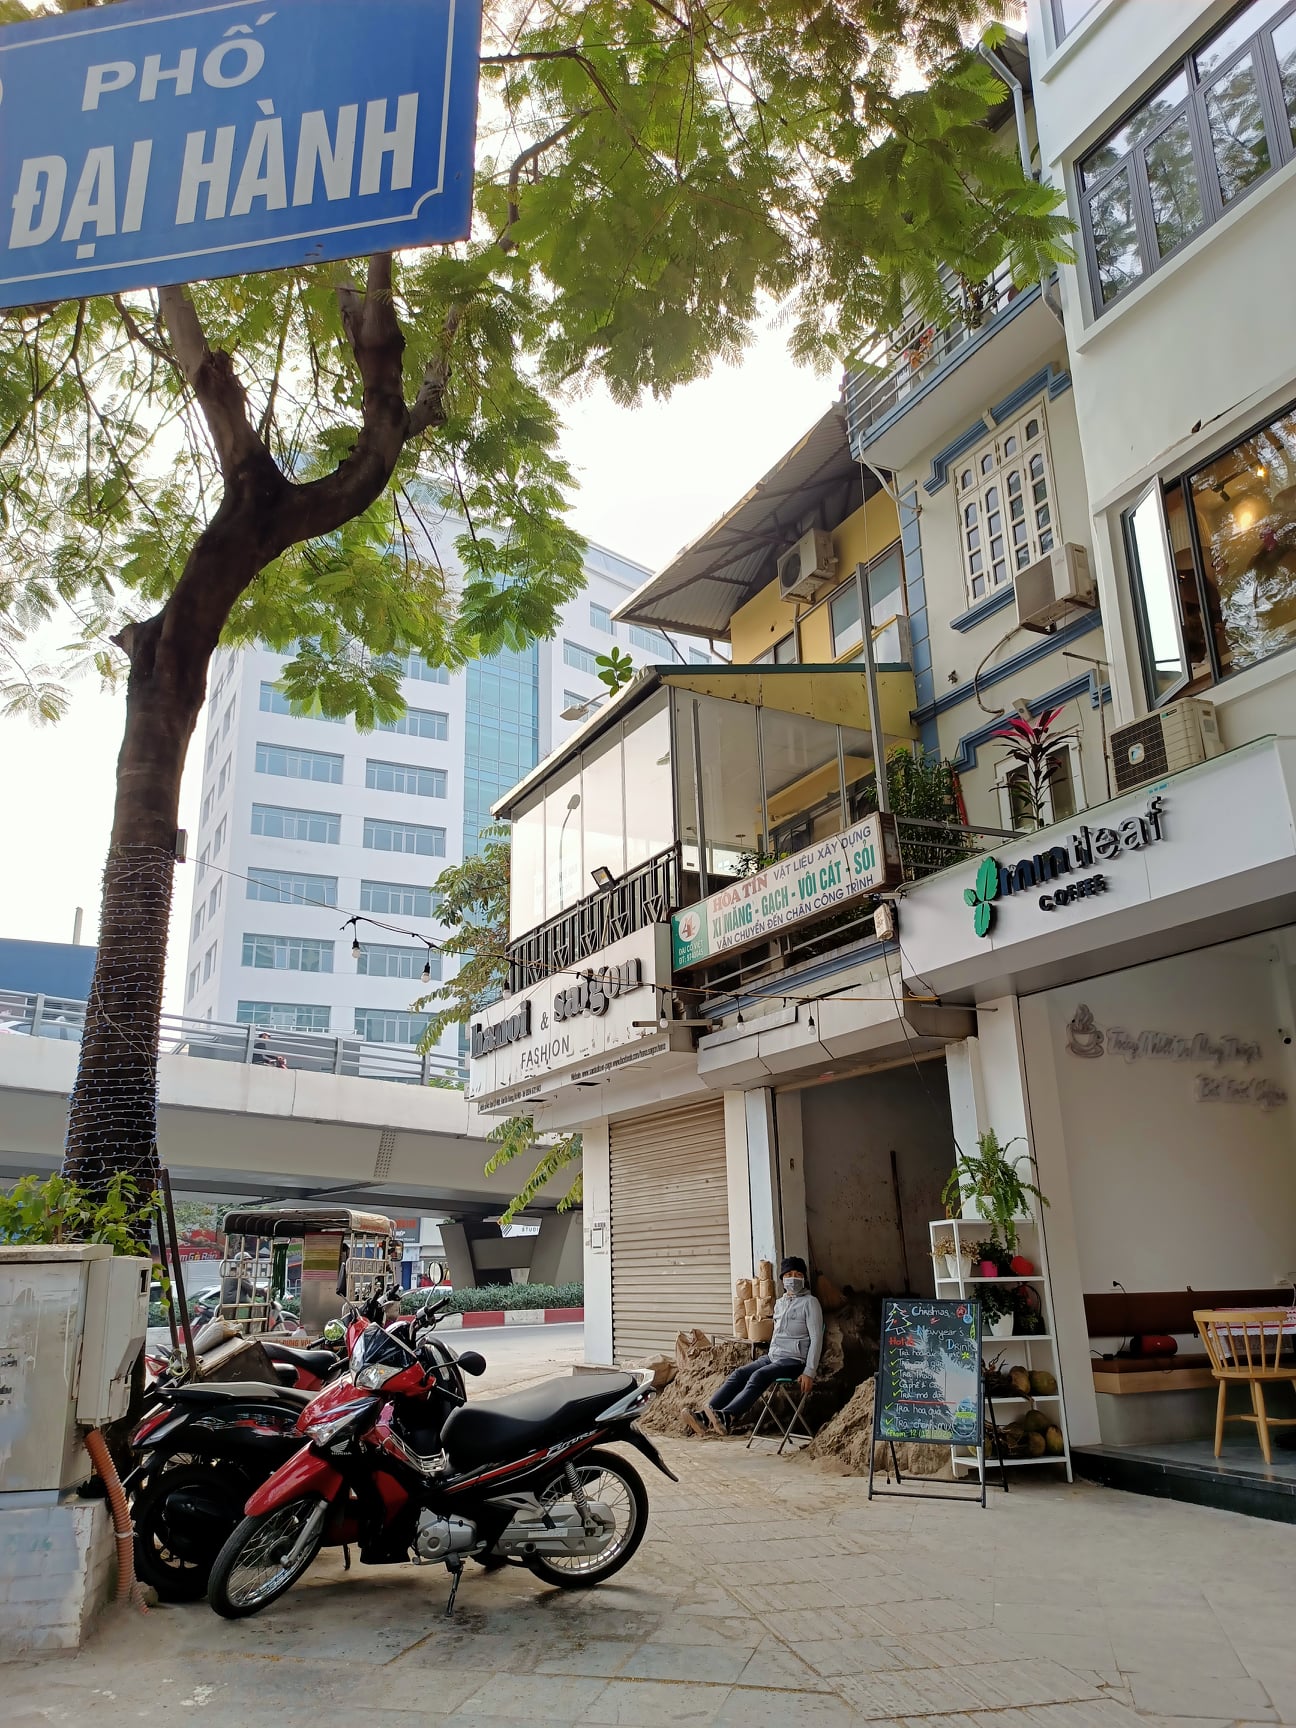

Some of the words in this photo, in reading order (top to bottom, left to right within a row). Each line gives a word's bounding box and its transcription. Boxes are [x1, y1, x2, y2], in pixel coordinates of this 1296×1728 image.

[81, 12, 277, 112] PHỐ
[8, 139, 153, 260] ĐẠI
[175, 92, 419, 226] HÀNH
[712, 917, 722, 939] XI
[724, 902, 753, 934] MĂNG
[761, 886, 789, 917] GẠCH
[798, 870, 817, 900] VÔI
[819, 860, 842, 890] CÁT
[854, 839, 876, 875] SỎI
[774, 863, 791, 881] VẬT
[793, 853, 814, 872] LIỆU
[817, 841, 838, 860] XÂY
[841, 826, 871, 849] DỰNG
[717, 935, 733, 950] VẬN
[734, 920, 765, 943] CHUYỂN
[767, 912, 784, 928] ĐẾN
[786, 902, 812, 920] CHÂN
[814, 889, 844, 909] CÔNG
[846, 874, 874, 895] TRÌNH
[1038, 873, 1109, 912] COFFEE
[471, 1000, 532, 1059] hanoi
[540, 1011, 549, 1031] &
[554, 958, 643, 1022] saigon
[521, 1035, 569, 1070] FASHION
[911, 1305, 949, 1316] Christmas
